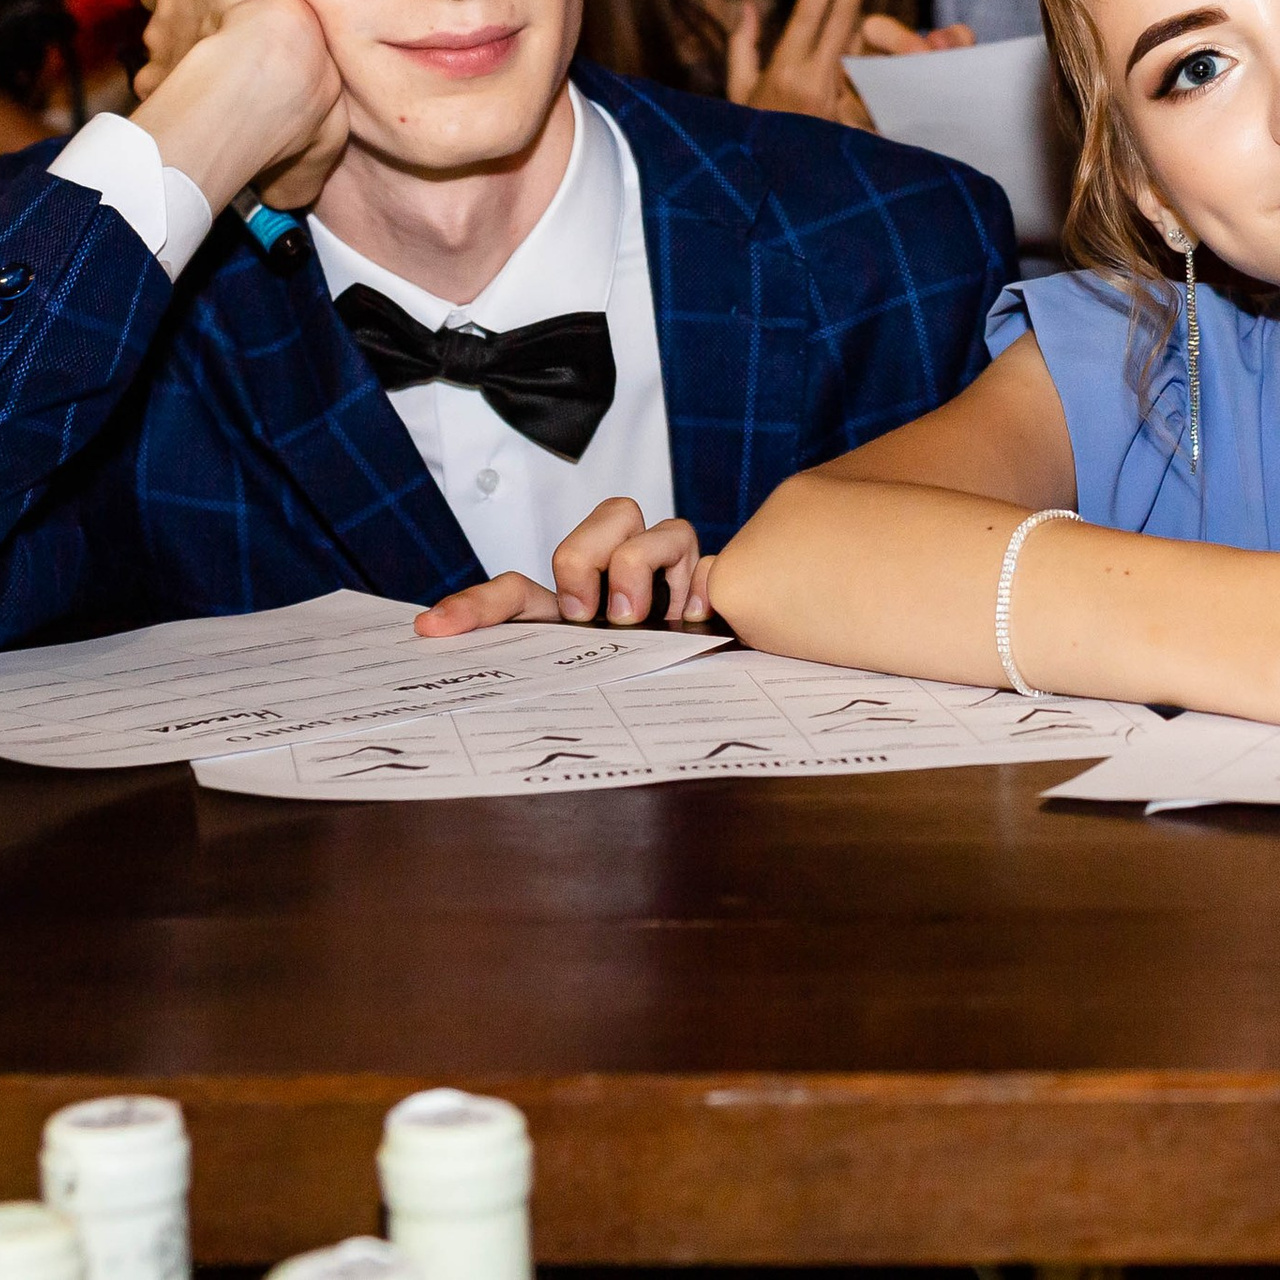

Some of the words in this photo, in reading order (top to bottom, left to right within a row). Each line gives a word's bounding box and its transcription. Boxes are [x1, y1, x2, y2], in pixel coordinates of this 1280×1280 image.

[335, 691, 505, 722] ШКОЛЬНОЕ
[226, 720, 332, 742] БИНГО
[665, 755, 887, 771] ШКОЛЬНОЕ
[523, 767, 652, 783] БИНГО
